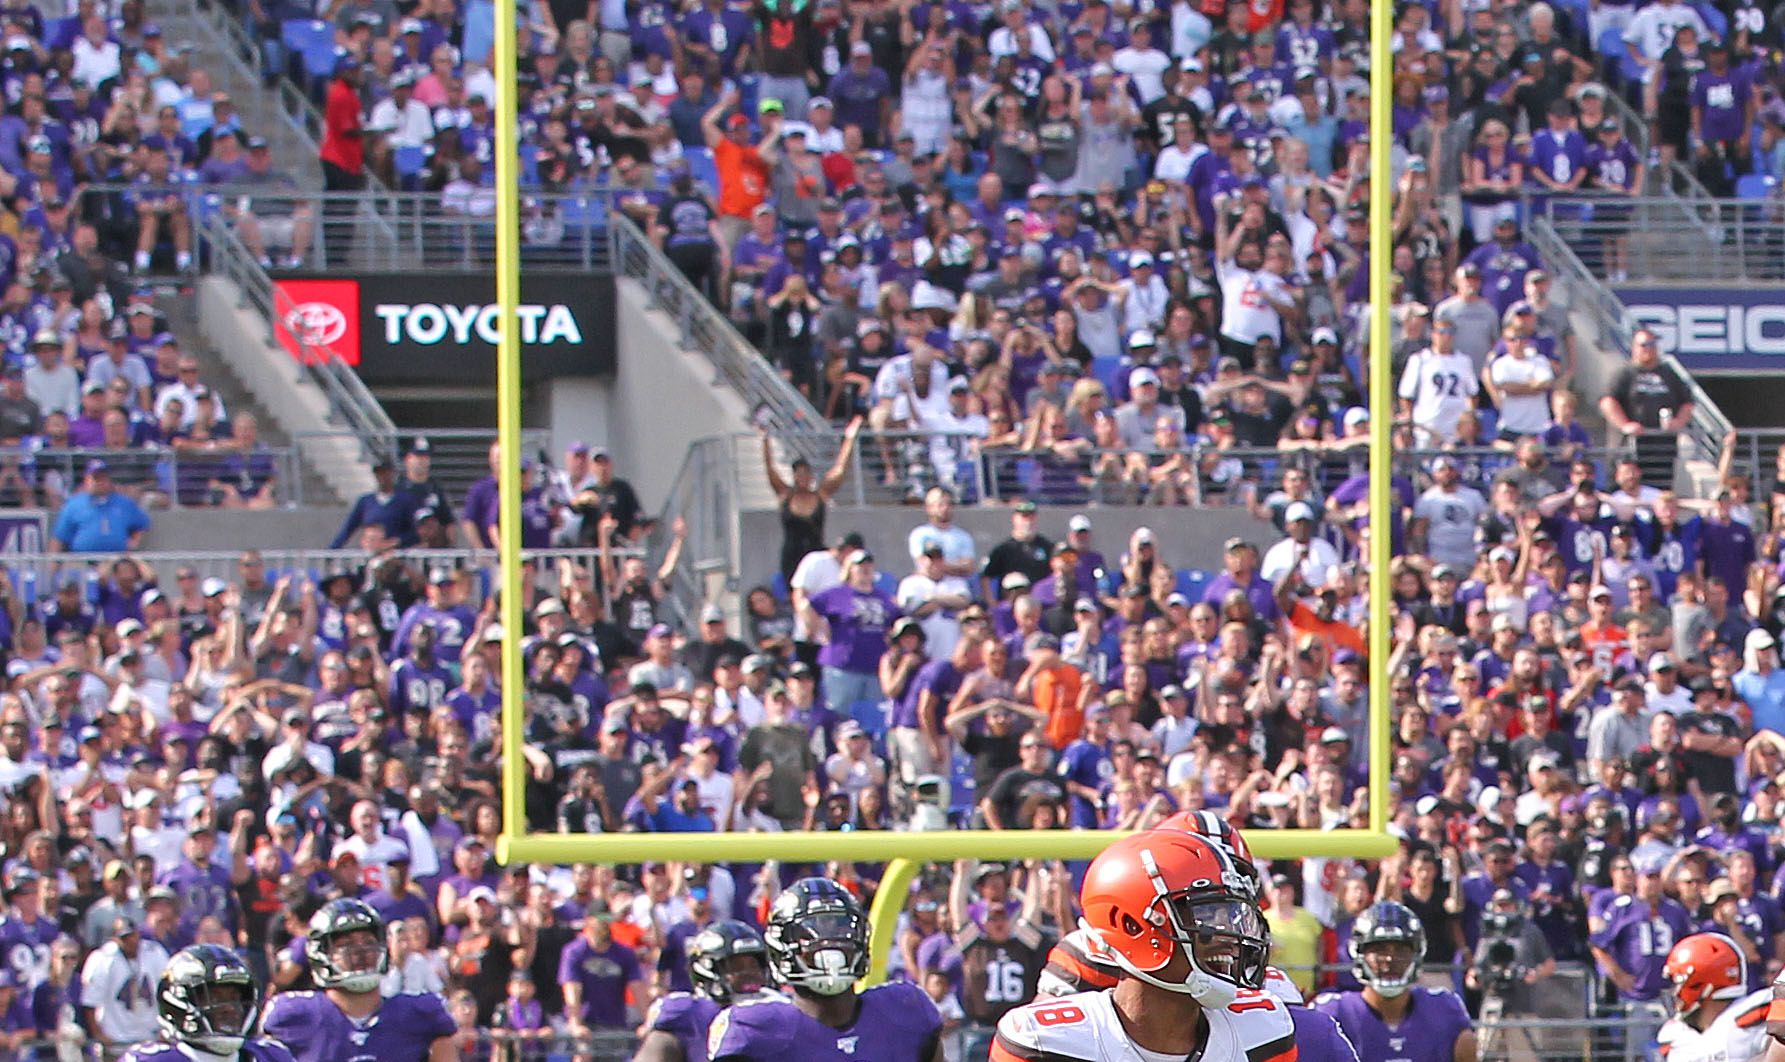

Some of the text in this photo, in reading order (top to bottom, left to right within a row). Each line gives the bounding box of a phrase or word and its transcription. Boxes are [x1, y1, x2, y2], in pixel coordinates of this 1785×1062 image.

[375, 303, 582, 344] TOYOTA
[1431, 371, 1460, 398] 92
[1638, 918, 1674, 956] 13
[983, 959, 1034, 1004] 16
